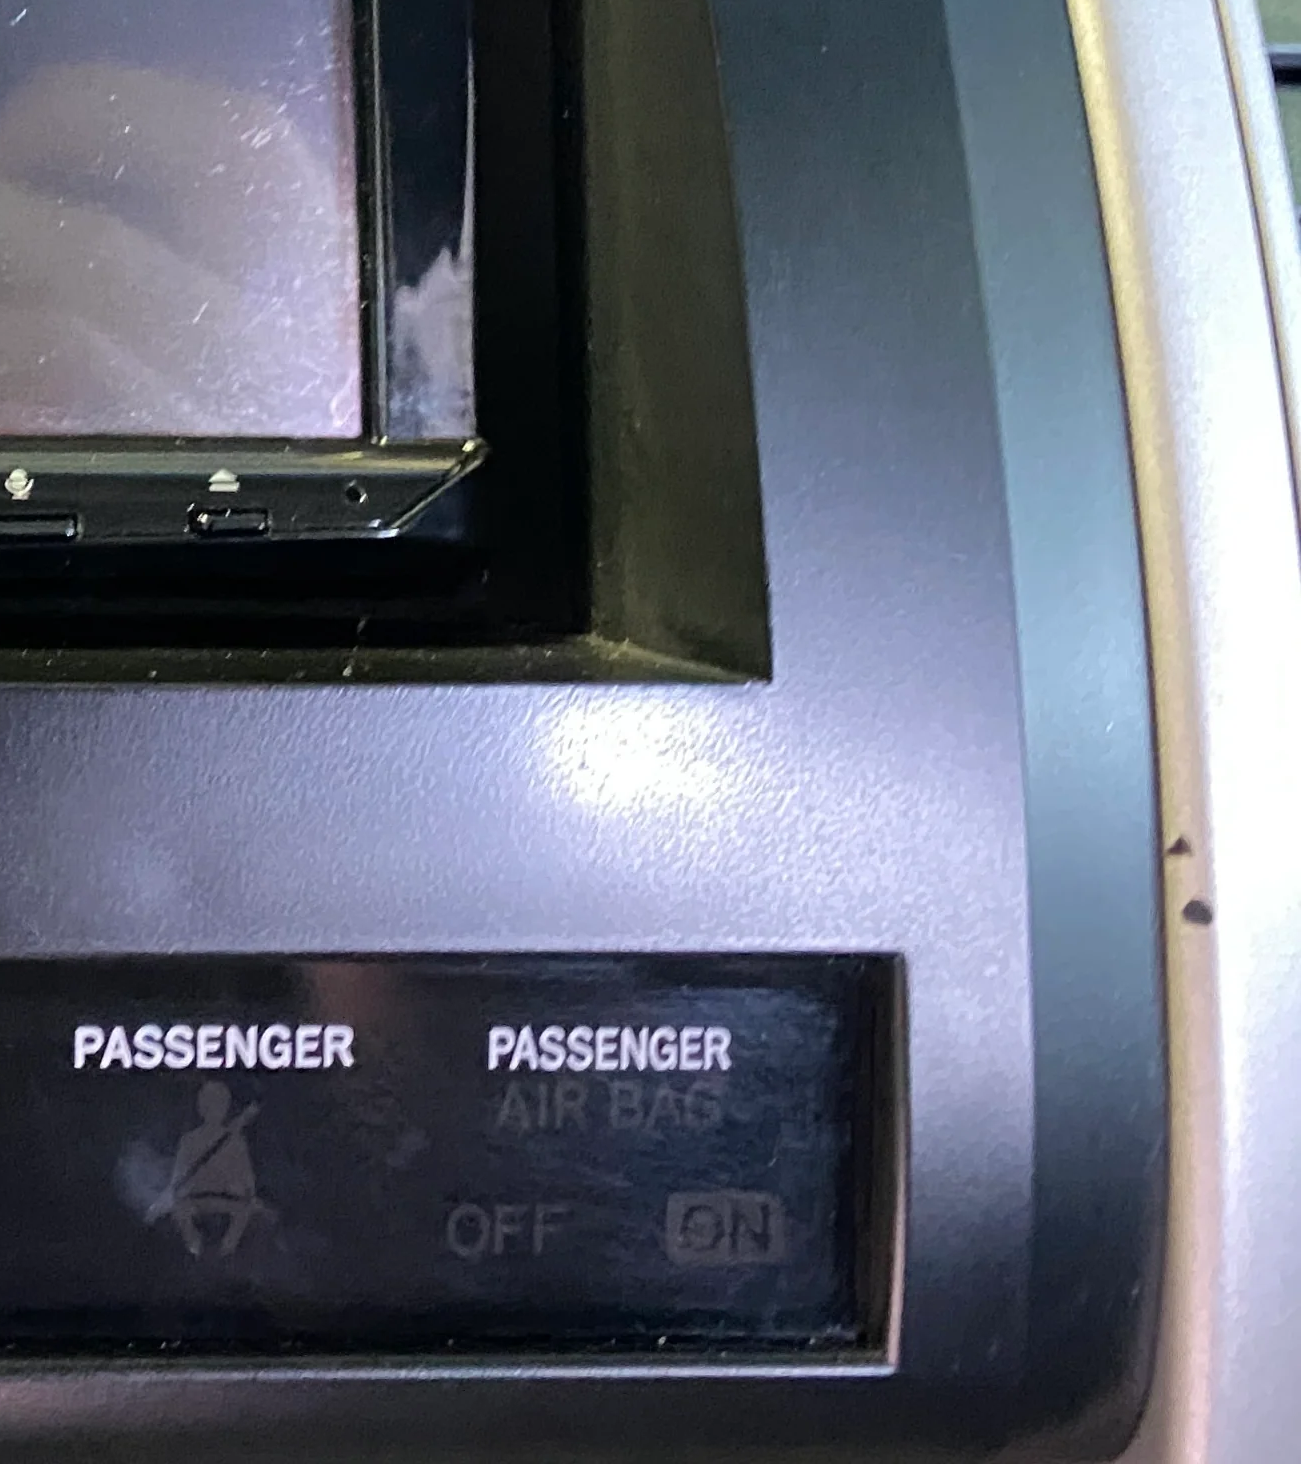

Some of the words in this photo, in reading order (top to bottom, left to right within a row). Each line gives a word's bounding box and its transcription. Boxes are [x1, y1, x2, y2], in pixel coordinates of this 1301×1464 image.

[72, 1024, 356, 1071] PASSENGER
[486, 1026, 733, 1073] PASSENGER
[497, 1081, 586, 1131] AIR
[608, 1081, 721, 1131] BAG
[446, 1203, 573, 1260] OFF
[678, 1201, 773, 1255] ON
